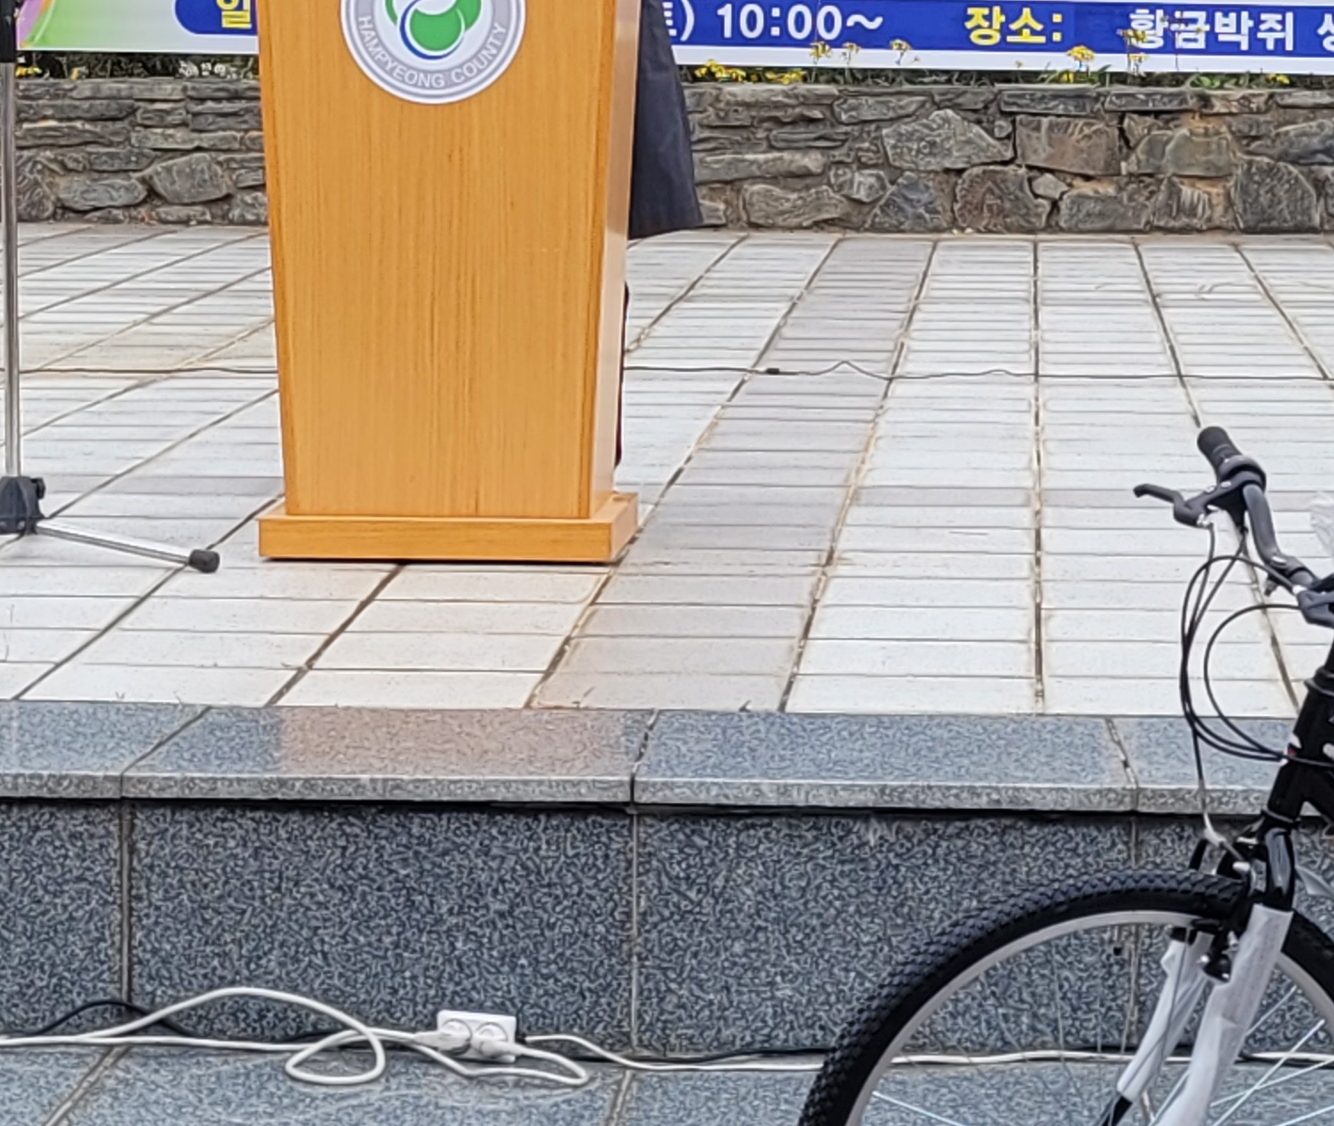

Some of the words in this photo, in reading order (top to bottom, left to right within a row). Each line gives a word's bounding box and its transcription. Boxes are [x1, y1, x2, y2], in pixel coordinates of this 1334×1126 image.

[358, 15, 446, 88] HAMPYEONG
[451, 22, 508, 84] COUNTY
[717, 2, 883, 41] 10:00~
[966, 4, 1063, 45] 장소:
[1129, 8, 1294, 51] 황금박쥐
